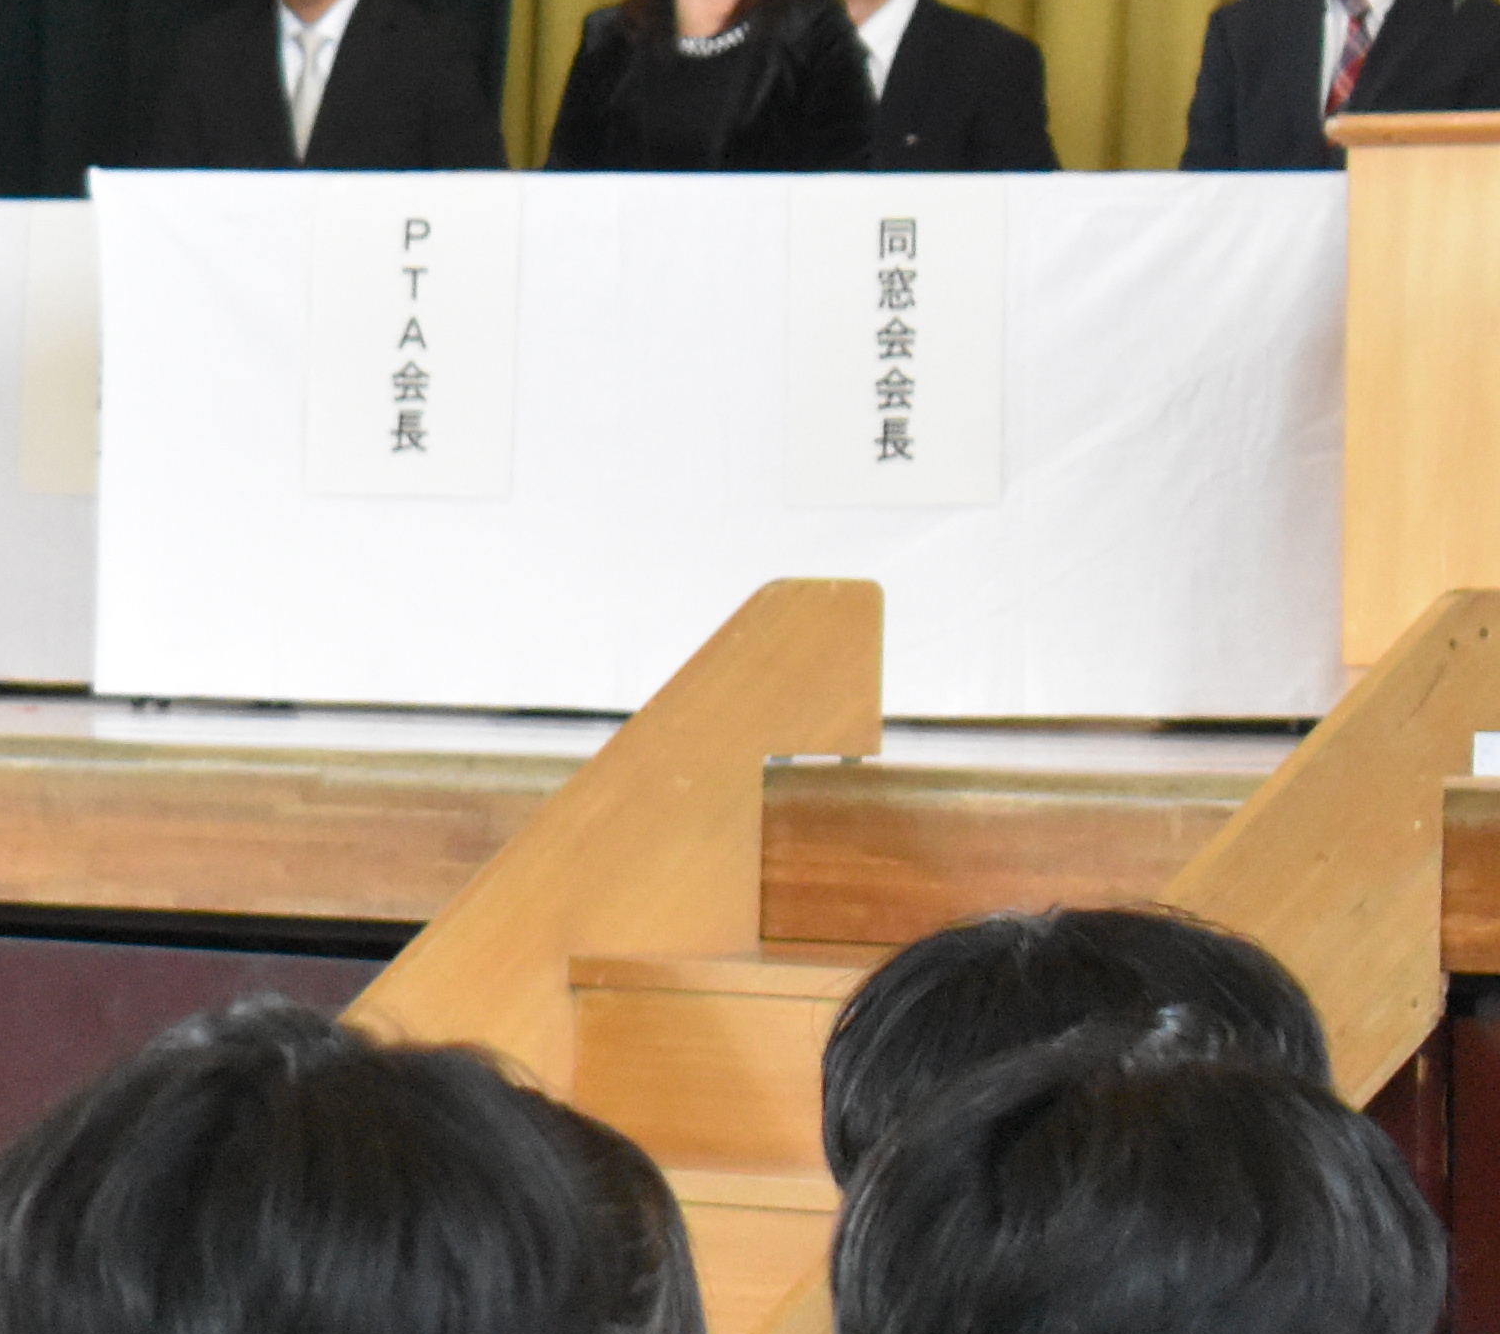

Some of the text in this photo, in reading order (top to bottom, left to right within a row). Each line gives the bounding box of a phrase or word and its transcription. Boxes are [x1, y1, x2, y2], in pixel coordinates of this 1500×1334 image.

[390, 217, 432, 455] PTA会長
[874, 217, 919, 462] 同窓会会長
